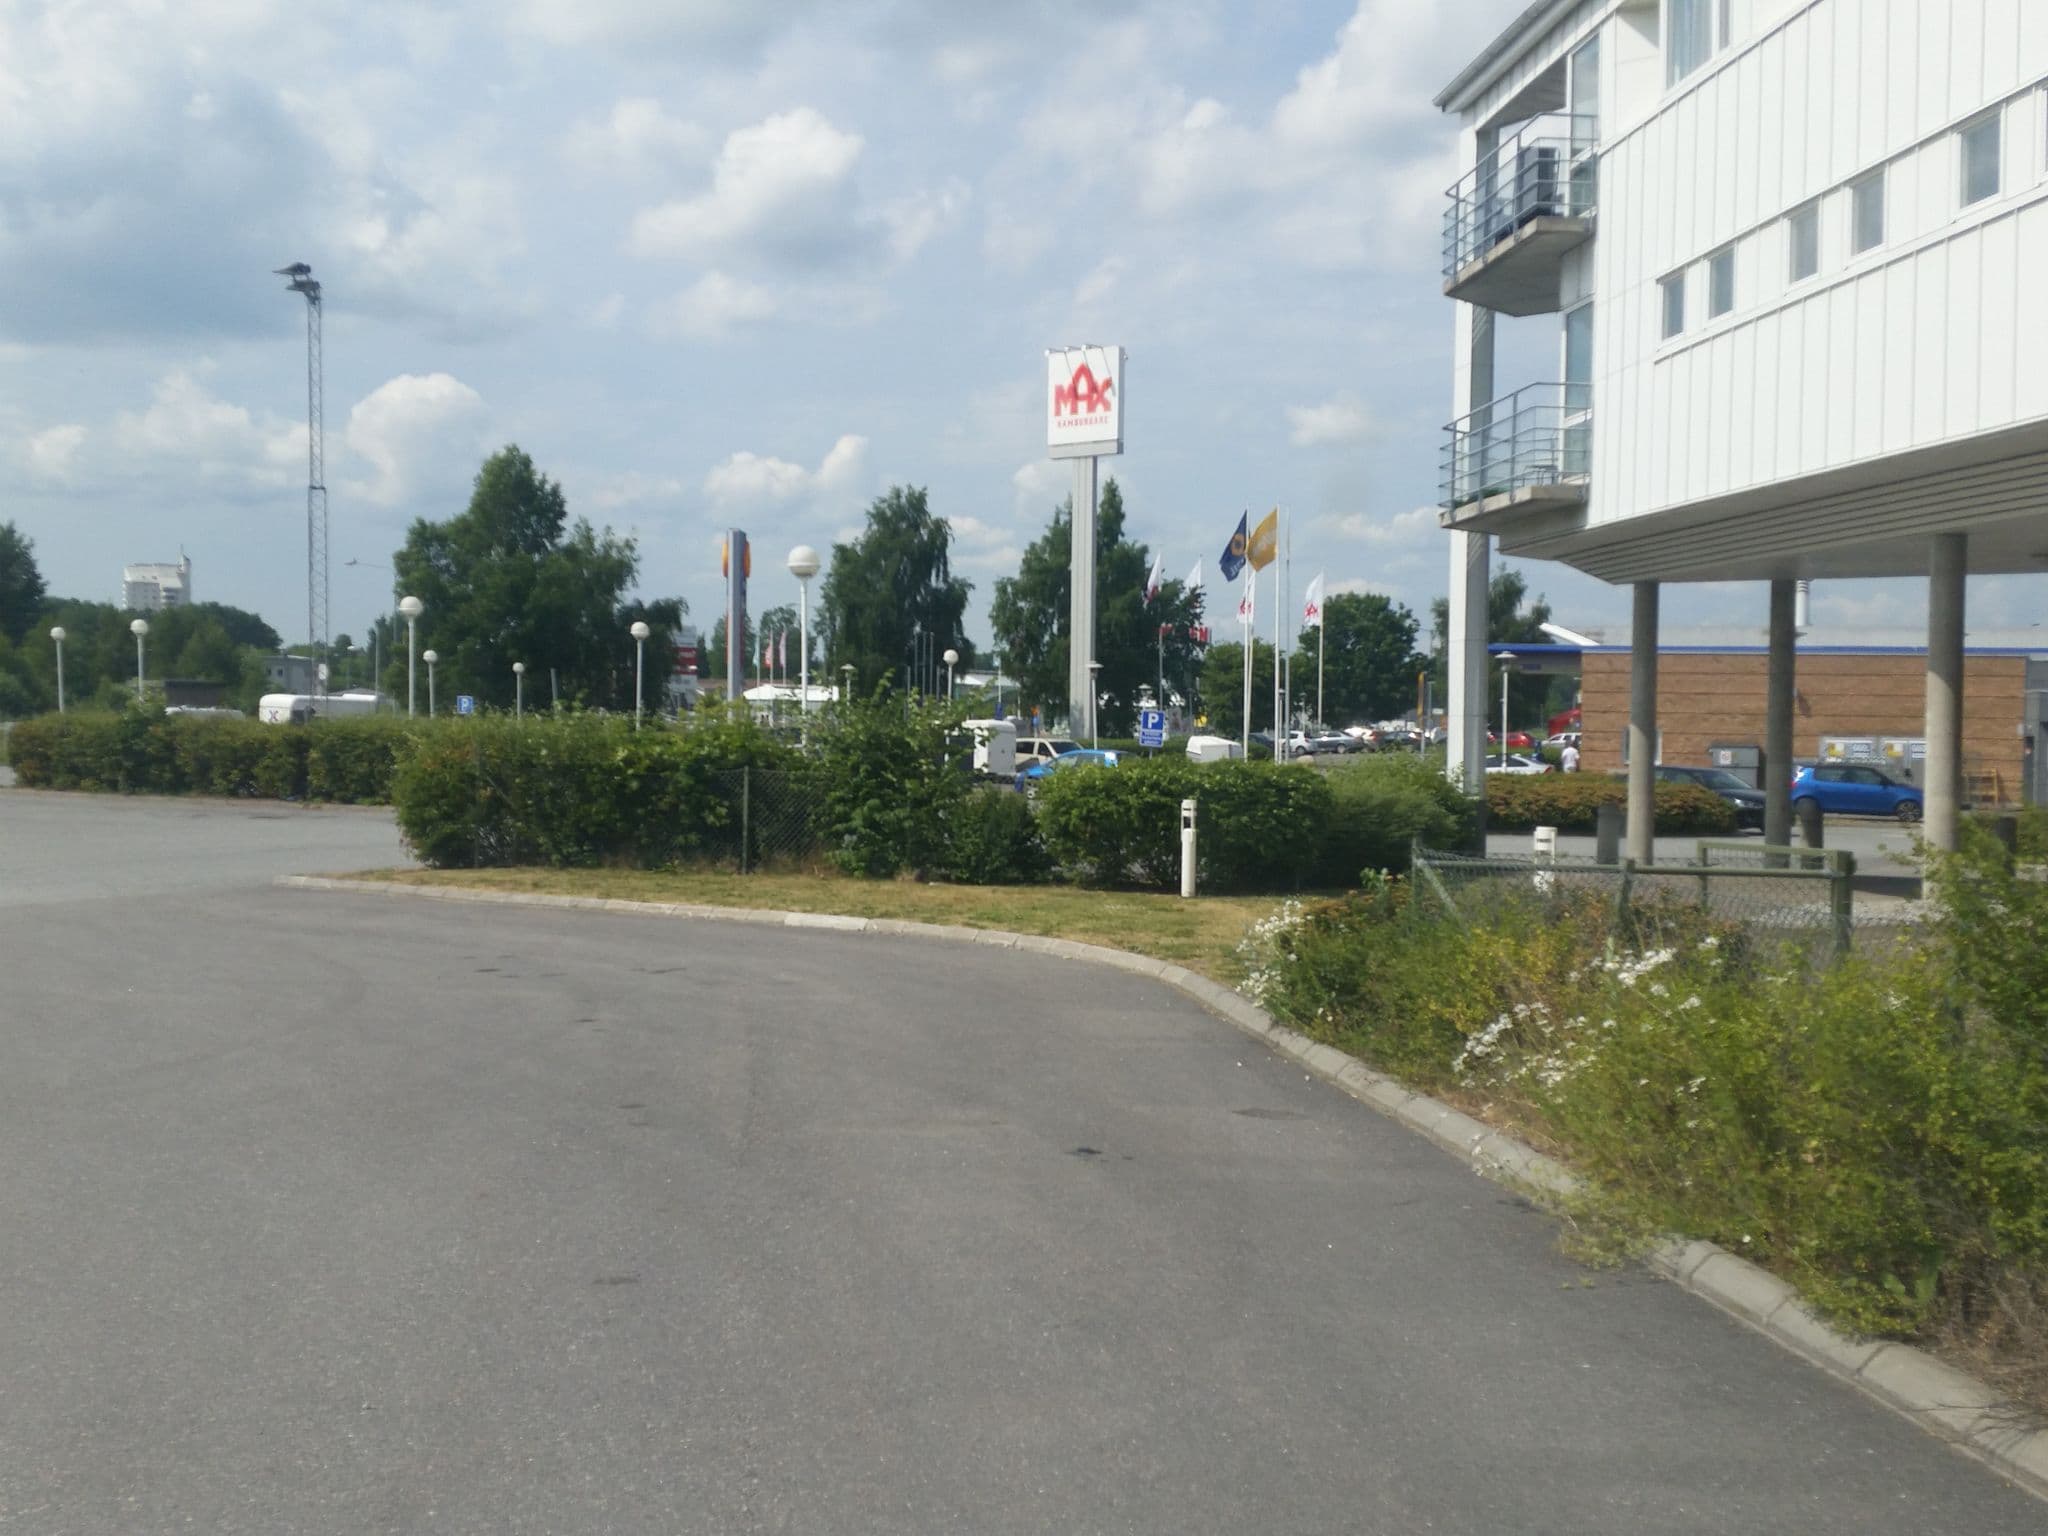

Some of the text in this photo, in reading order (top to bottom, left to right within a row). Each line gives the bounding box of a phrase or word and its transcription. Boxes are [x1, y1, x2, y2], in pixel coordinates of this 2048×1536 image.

[1055, 363, 1111, 416] MAX
[461, 698, 469, 711] P
[1148, 713, 1159, 729] P
